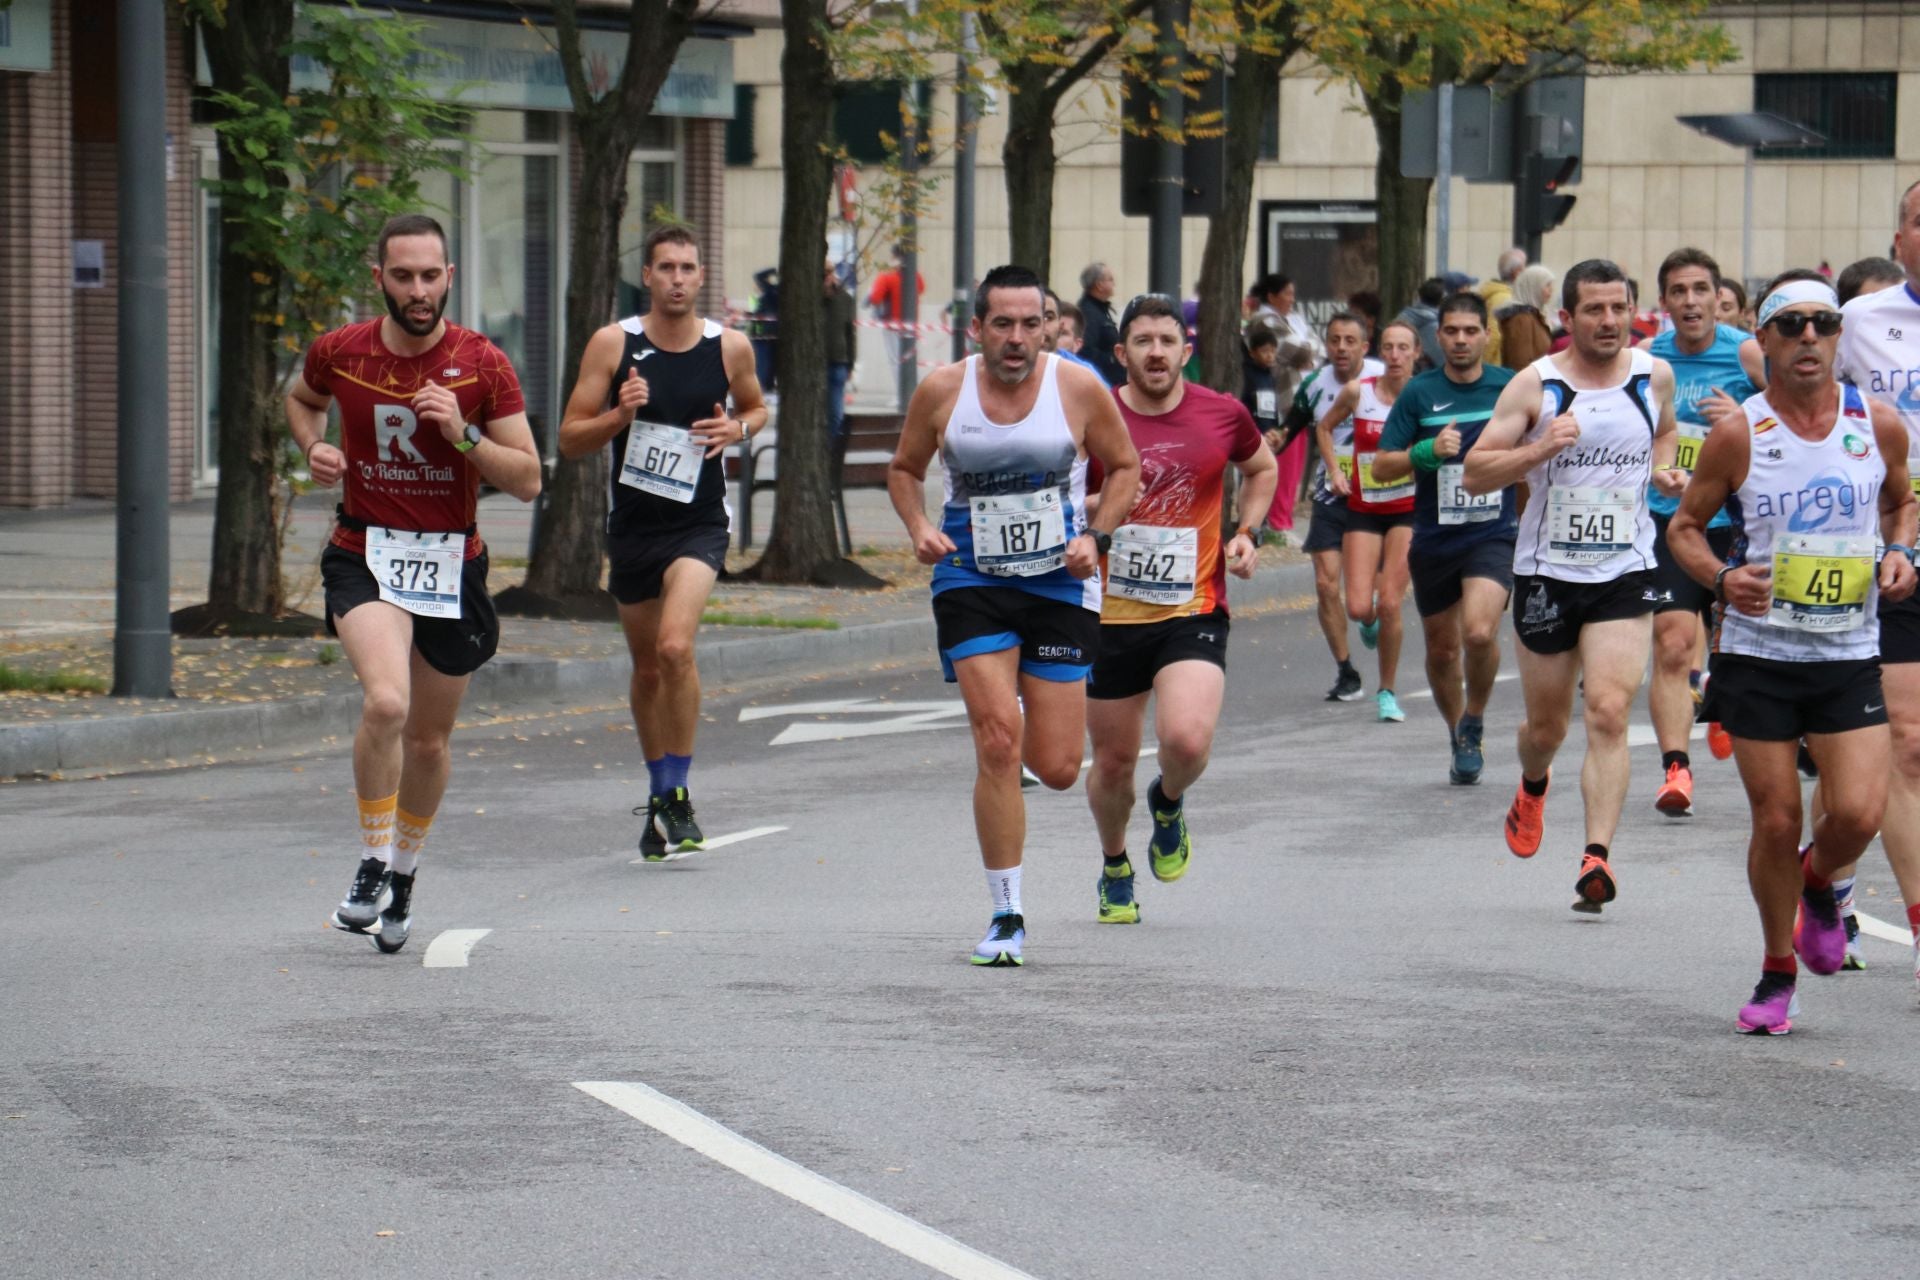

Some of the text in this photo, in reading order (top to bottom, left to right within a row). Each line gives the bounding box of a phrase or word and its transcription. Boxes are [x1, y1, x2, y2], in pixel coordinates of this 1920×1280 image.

[373, 404, 428, 464] R
[375, 463, 419, 481] Reina
[419, 465, 455, 482] Trail
[644, 446, 682, 477] 617
[1556, 447, 1648, 474] intelligent
[1000, 520, 1041, 554] 187
[1568, 514, 1614, 542] 549
[389, 558, 439, 592] 373
[1013, 557, 1054, 572] HYUNDAI
[1128, 551, 1175, 583] 542
[1138, 585, 1179, 600] HYUNDAI
[1805, 569, 1843, 604] 49
